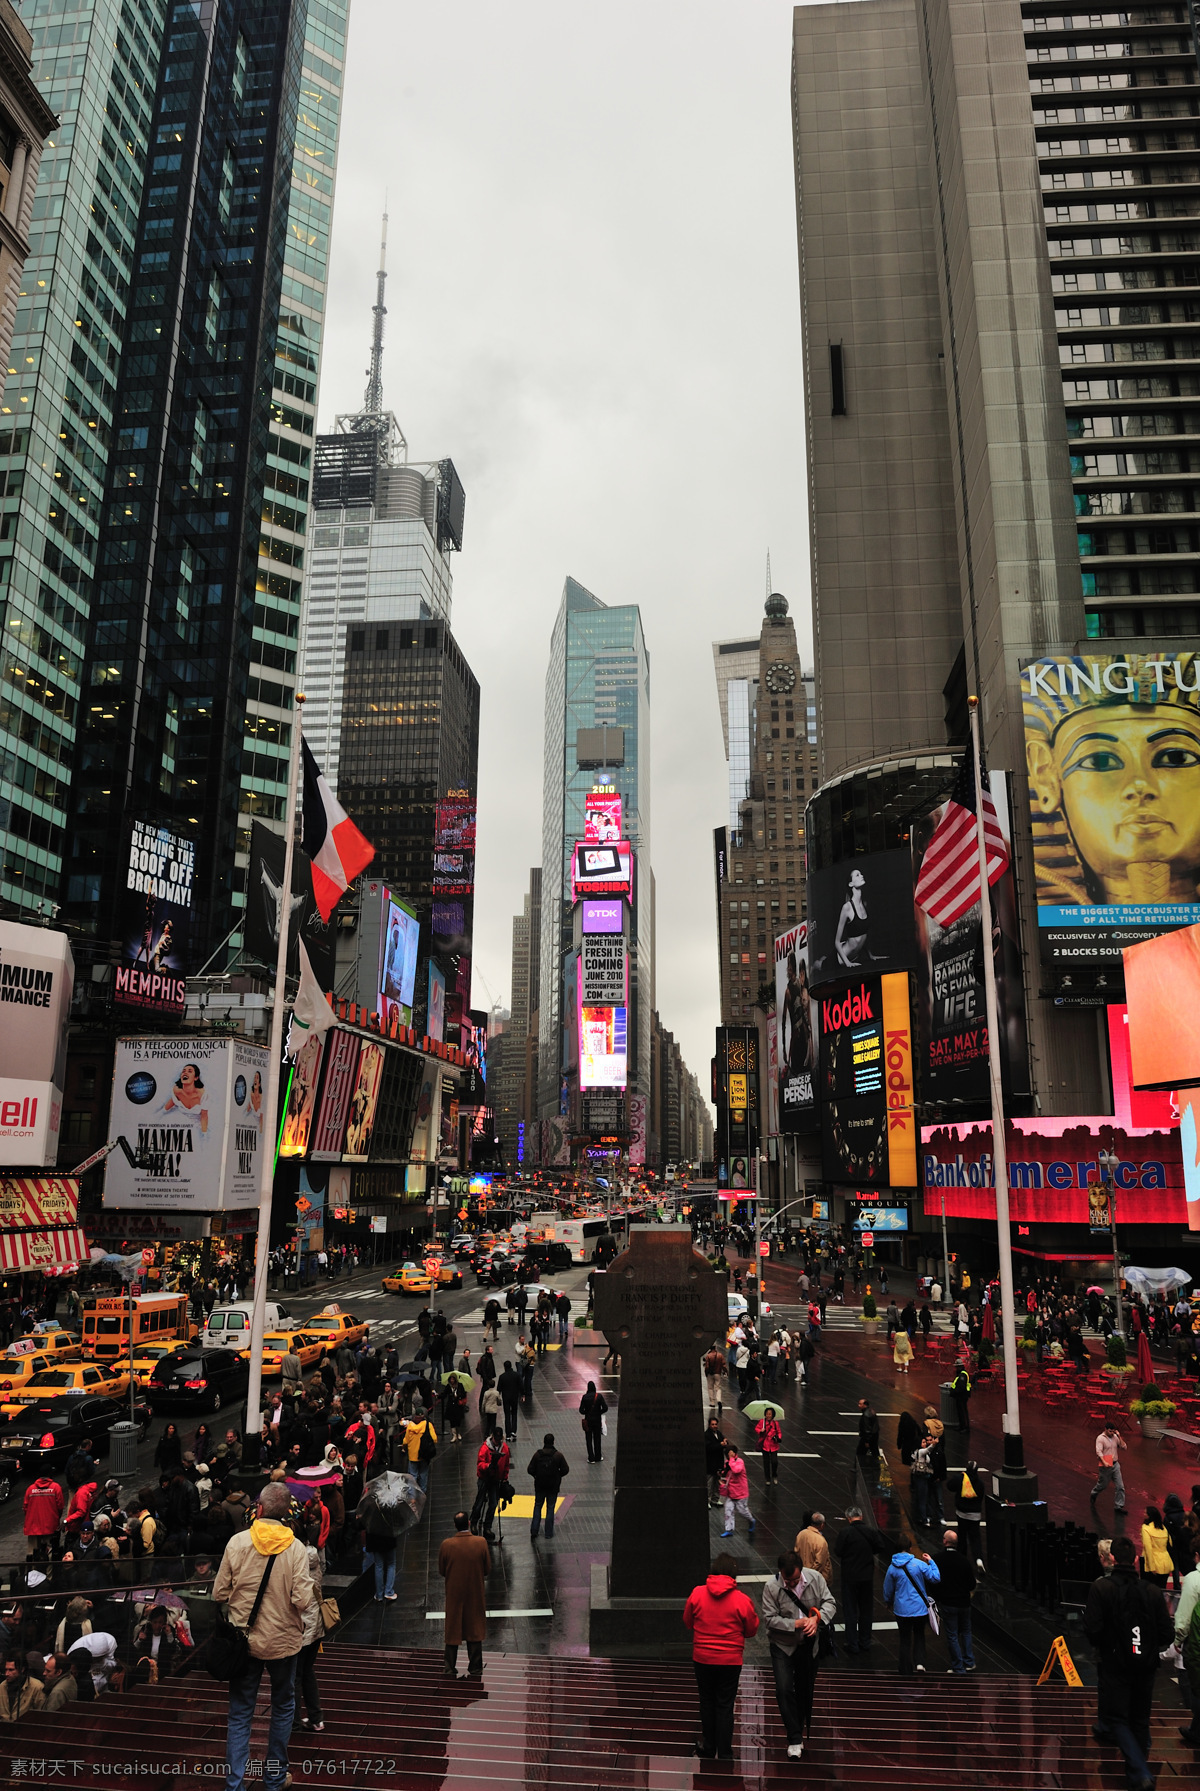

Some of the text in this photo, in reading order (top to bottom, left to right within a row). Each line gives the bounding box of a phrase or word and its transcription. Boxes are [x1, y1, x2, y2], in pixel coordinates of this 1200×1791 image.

[1028, 660, 1200, 697] KING TU
[592, 785, 615, 794] 2010
[586, 793, 620, 801] TOSHIBA
[135, 820, 194, 851] THE NEW MUSICAL THAT'S
[131, 830, 195, 867] BLOWING THE
[129, 846, 194, 887] ROOF OFF
[127, 868, 192, 908] BROADWAY!
[575, 882, 629, 892] TOSHIBA
[1060, 908, 1078, 916] THE
[1080, 907, 1120, 916] BIGGEST
[1123, 906, 1190, 915] BLOCKBUSTER
[1084, 916, 1096, 924] OF
[1099, 916, 1117, 924] ALL
[1144, 915, 1189, 923] RETURNS
[585, 939, 623, 947] SOMETHING
[775, 929, 798, 962] MAY
[799, 925, 809, 950] 2
[585, 947, 623, 957] FRESH IS
[1061, 948, 1098, 956] BLOCKS
[585, 959, 623, 970] COMING
[585, 971, 623, 980] JUNE 2010
[116, 966, 185, 1003] MEMPHIS
[585, 990, 603, 999] .COM
[935, 984, 948, 1001] VS
[823, 983, 874, 1034] Kodak
[943, 989, 975, 1025] UFC
[145, 1041, 189, 1050] FEEL-GOOD
[192, 1040, 228, 1050] MUSICAL
[864, 1036, 880, 1051] SQUARE
[929, 1038, 952, 1058] SAT.
[954, 1030, 978, 1052] MAY
[134, 1050, 141, 1059] IS
[143, 1051, 149, 1059] A
[930, 1056, 942, 1067] LIVE
[944, 1055, 952, 1064] ON
[604, 1066, 622, 1075] BEER
[788, 1074, 811, 1087] PRINCE OF
[886, 1029, 912, 1131] Kodak
[731, 1086, 745, 1095] LION
[783, 1082, 814, 1104] PERSIA
[731, 1095, 746, 1104] KING
[0, 1097, 38, 1128] ell
[137, 1128, 193, 1152] MAMMA
[235, 1128, 257, 1151] MAMMA
[587, 1149, 620, 1158] YAHO!
[146, 1152, 182, 1177] MIA!
[238, 1152, 252, 1174] MIA!
[924, 1151, 1167, 1190] Bank of merica
[42, 1200, 65, 1208] FRIDAY'S
[85, 1215, 167, 1228] DIGITAL
[1090, 1217, 1108, 1225] TUT
[33, 1245, 50, 1254] FRIDAY'S
[620, 1293, 659, 1302] FRANCIS
[670, 1293, 703, 1302] DUFFY
[1131, 1625, 1142, 1656] FILA
